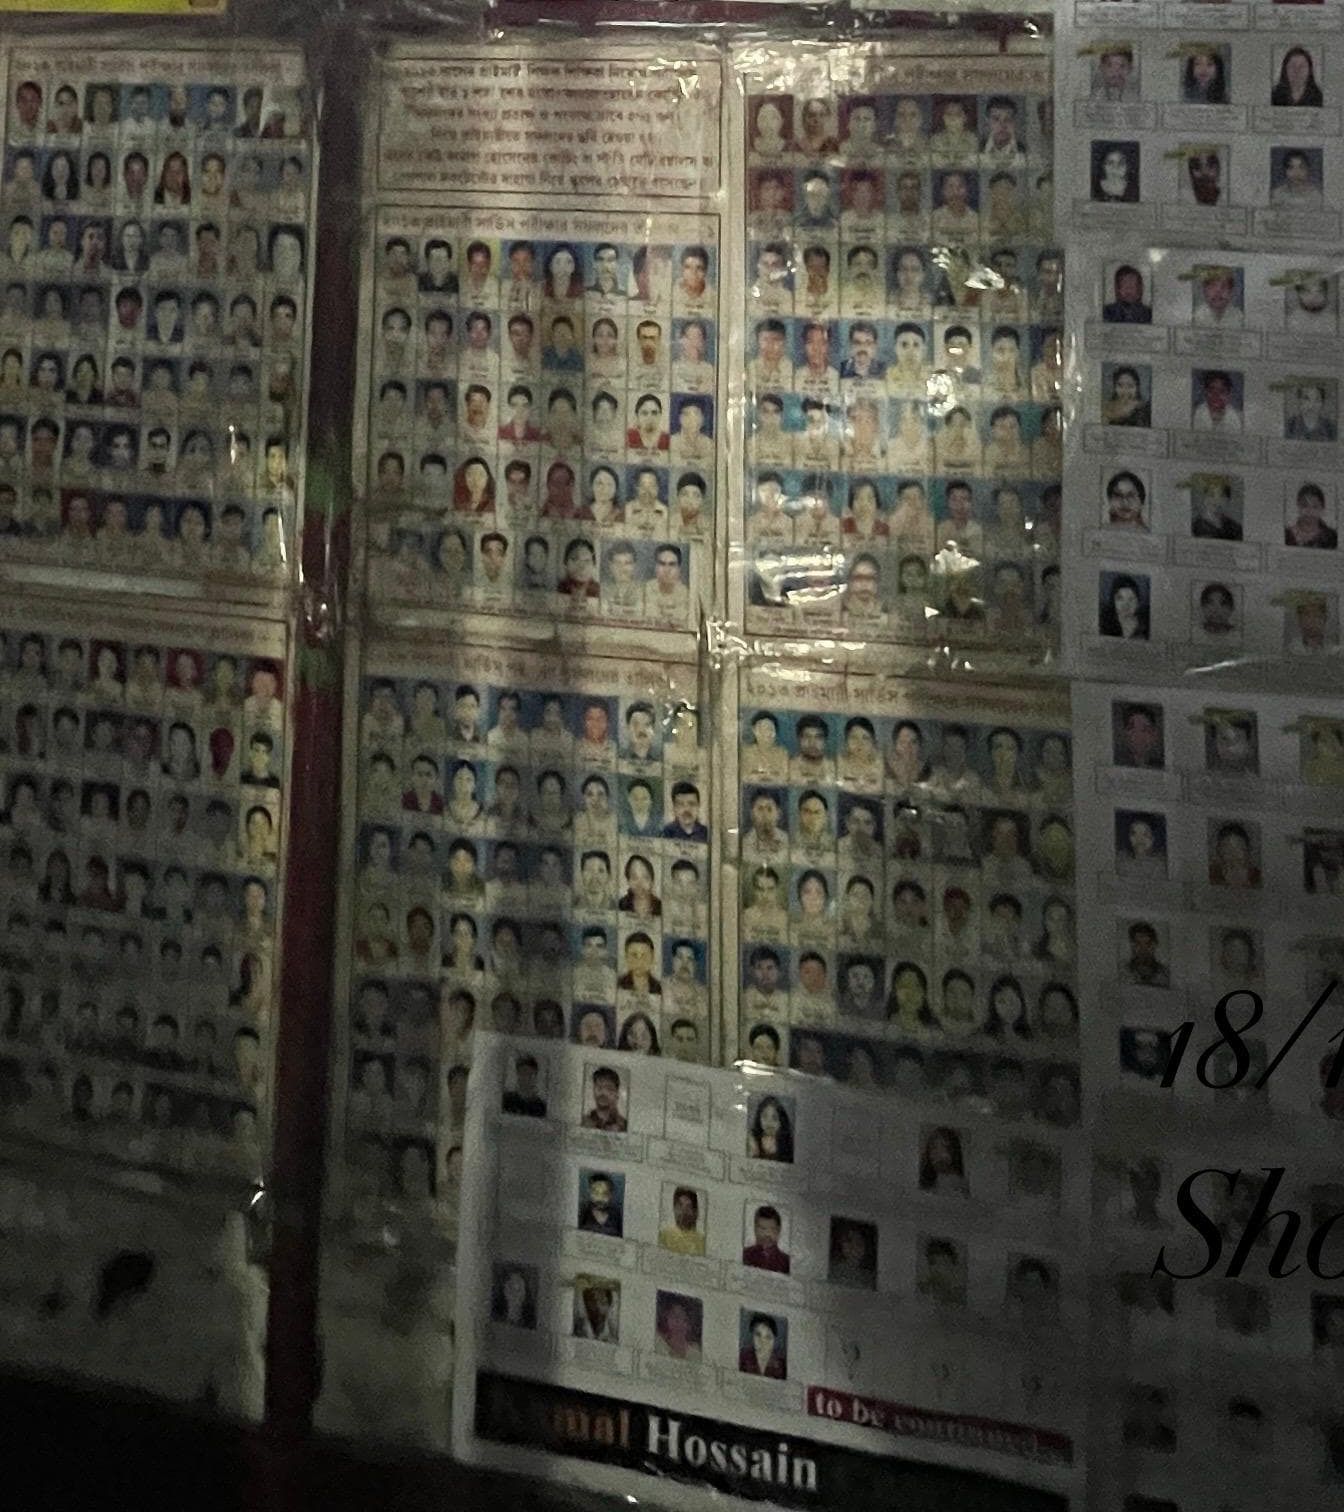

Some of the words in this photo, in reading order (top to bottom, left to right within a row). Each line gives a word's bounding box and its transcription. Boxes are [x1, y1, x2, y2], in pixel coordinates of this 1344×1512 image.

[814, 1391, 843, 1420] to
[852, 1397, 884, 1428] be
[646, 1412, 818, 1493] Hossain
